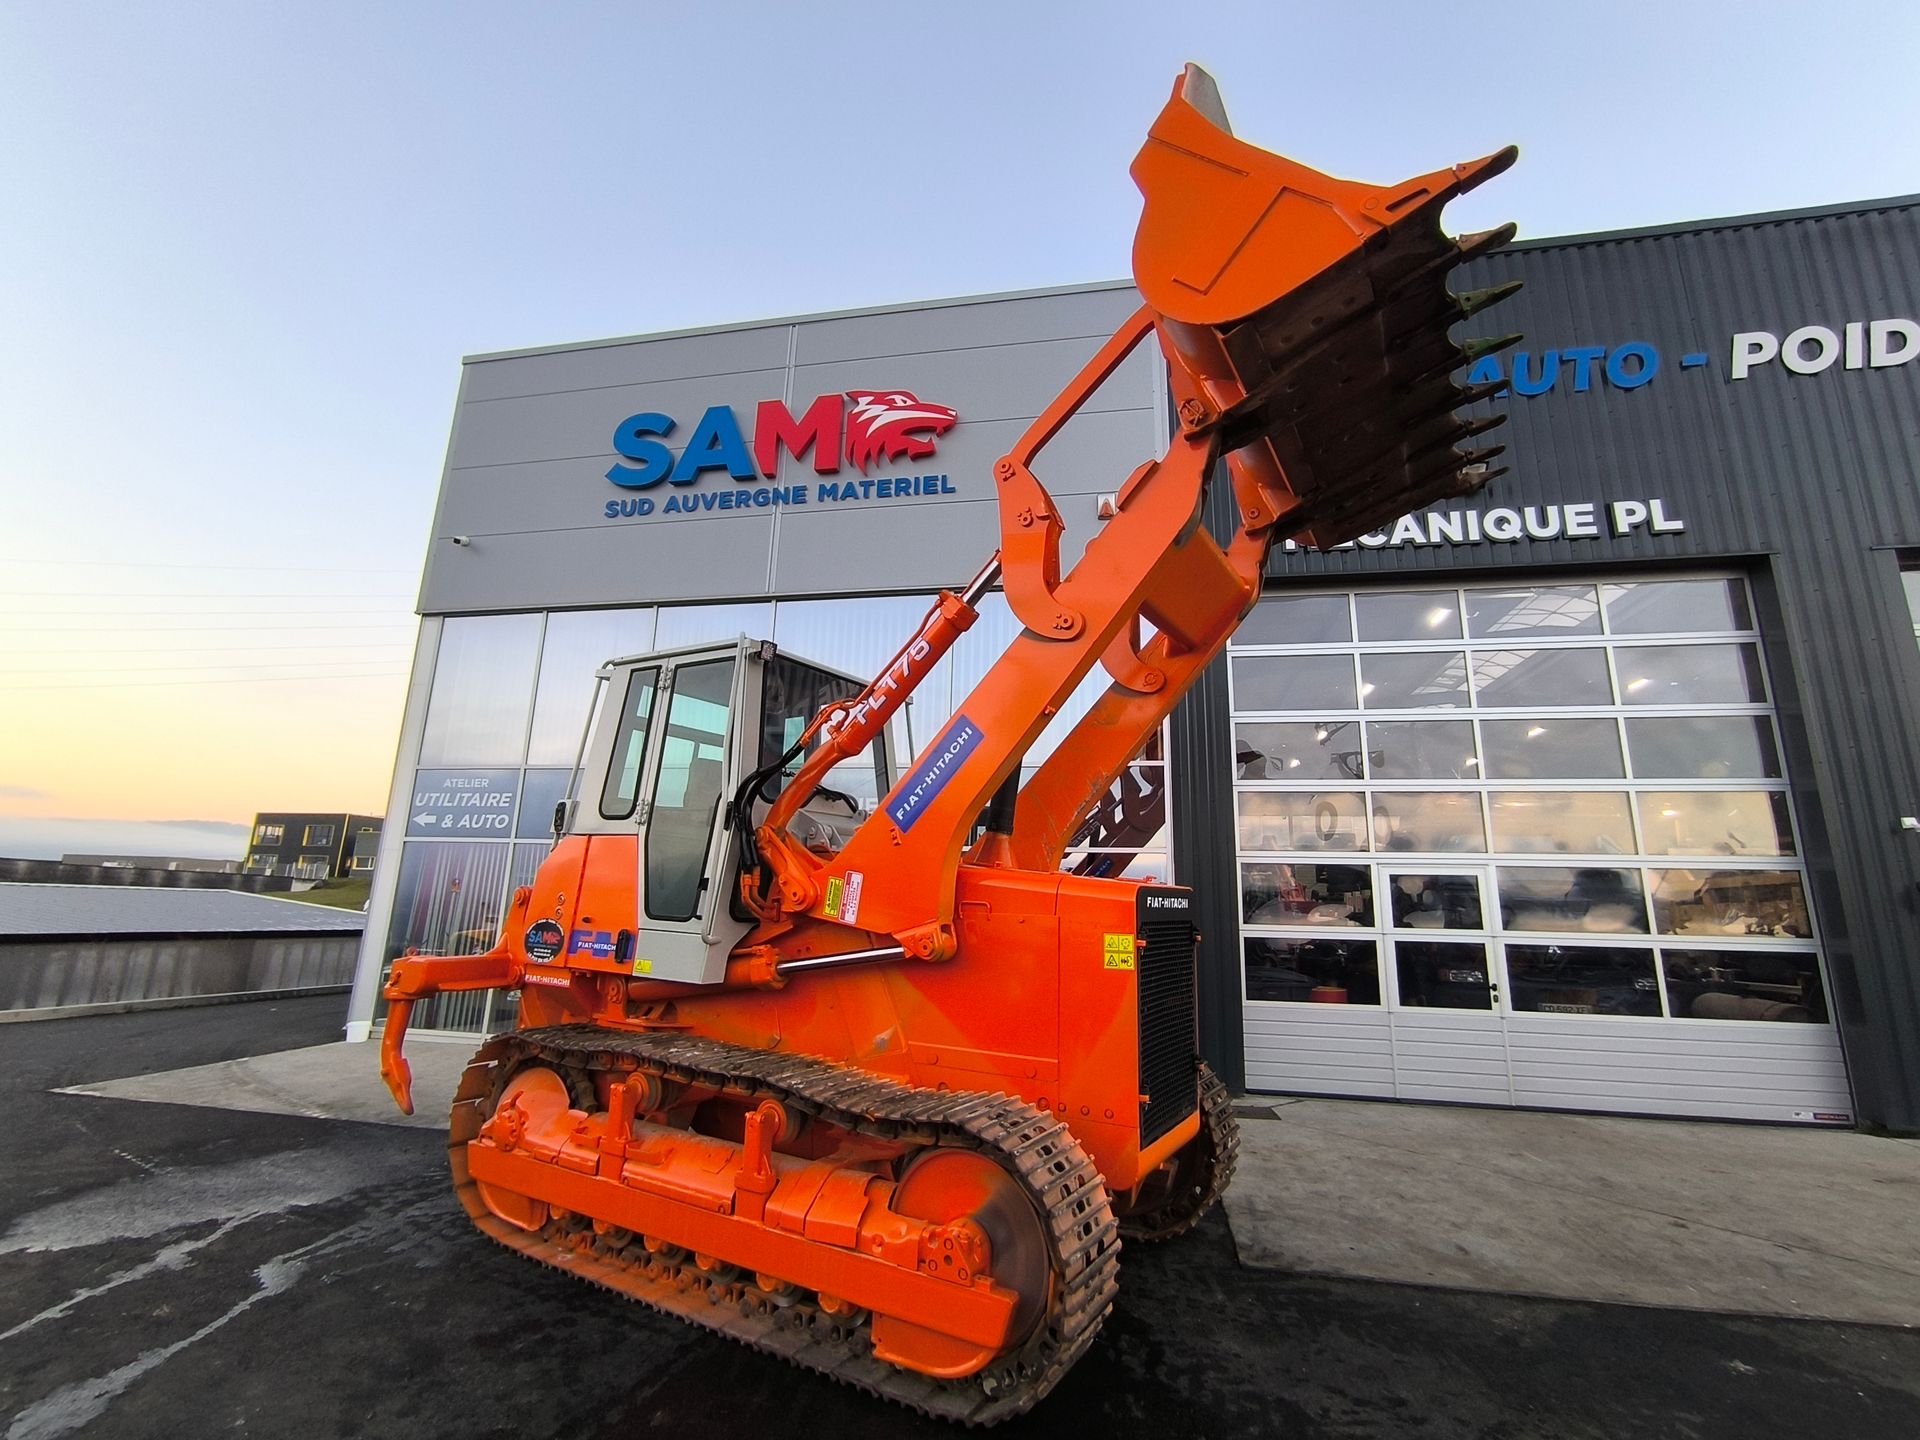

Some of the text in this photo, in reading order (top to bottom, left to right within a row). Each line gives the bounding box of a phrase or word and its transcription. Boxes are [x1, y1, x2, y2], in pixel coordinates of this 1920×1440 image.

[1467, 341, 1659, 398] AUTO
[1731, 318, 1920, 380] POID
[605, 393, 845, 490] SAM
[605, 474, 956, 519] SUD AUVERGNE MATERIEL
[1284, 498, 1684, 550] ANIQUE PL
[896, 727, 973, 820] FIAT-HITACHI
[443, 778, 489, 788] ATELIER
[415, 792, 512, 807] UTILITAIRE
[441, 814, 509, 828] & AUTO
[1147, 897, 1189, 908] FIAT-HITACHI
[577, 941, 617, 951] FIAT-HITACH
[525, 974, 570, 986] FIAT-HITACHI
